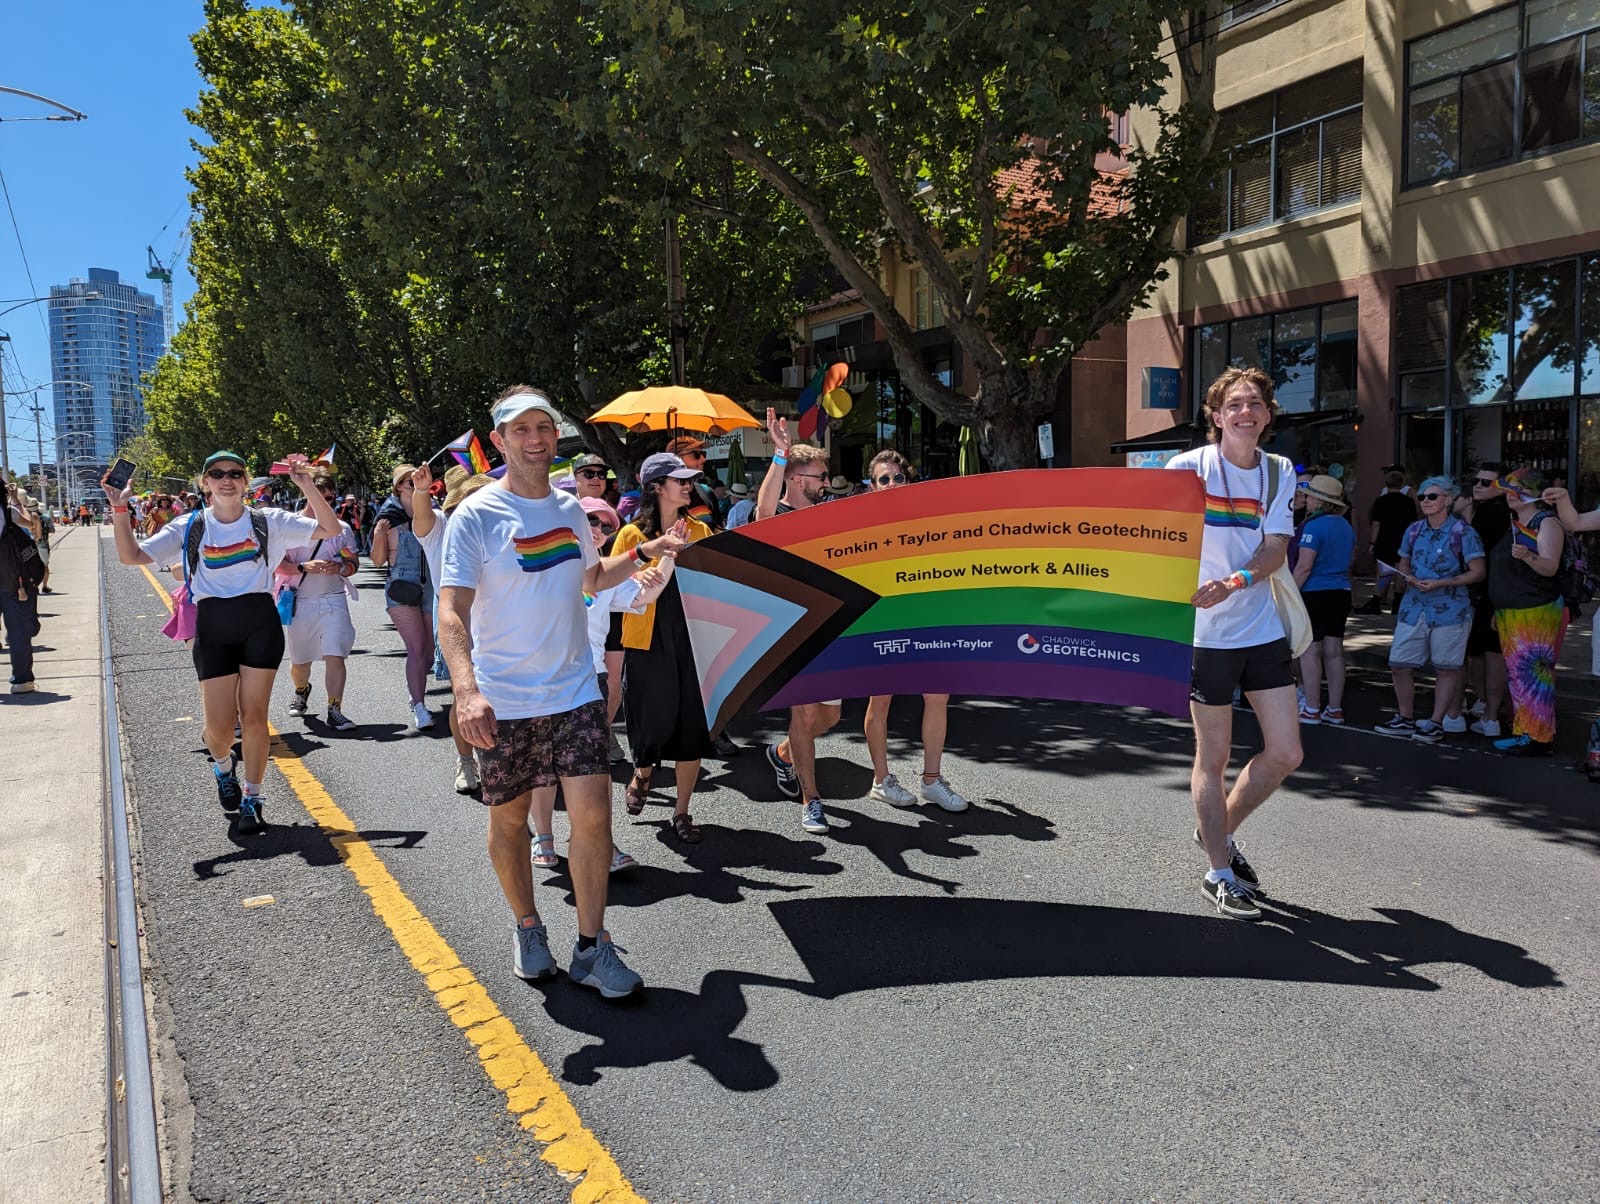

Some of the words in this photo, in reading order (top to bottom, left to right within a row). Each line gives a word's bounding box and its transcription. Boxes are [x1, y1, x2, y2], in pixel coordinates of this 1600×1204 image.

[824, 541, 878, 559] Tonkin
[883, 538, 893, 547] +
[897, 531, 948, 546] Taylor
[952, 525, 983, 539] and
[988, 521, 1072, 536] Chadwick
[1077, 522, 1188, 542] Geotechnics
[896, 567, 966, 583] Rainbow
[971, 562, 1039, 576] Network
[1045, 562, 1057, 575] &
[1062, 563, 1110, 578] Allies
[1041, 635, 1097, 647] CHADWICK
[1041, 644, 1141, 663] GEOTECHNICS
